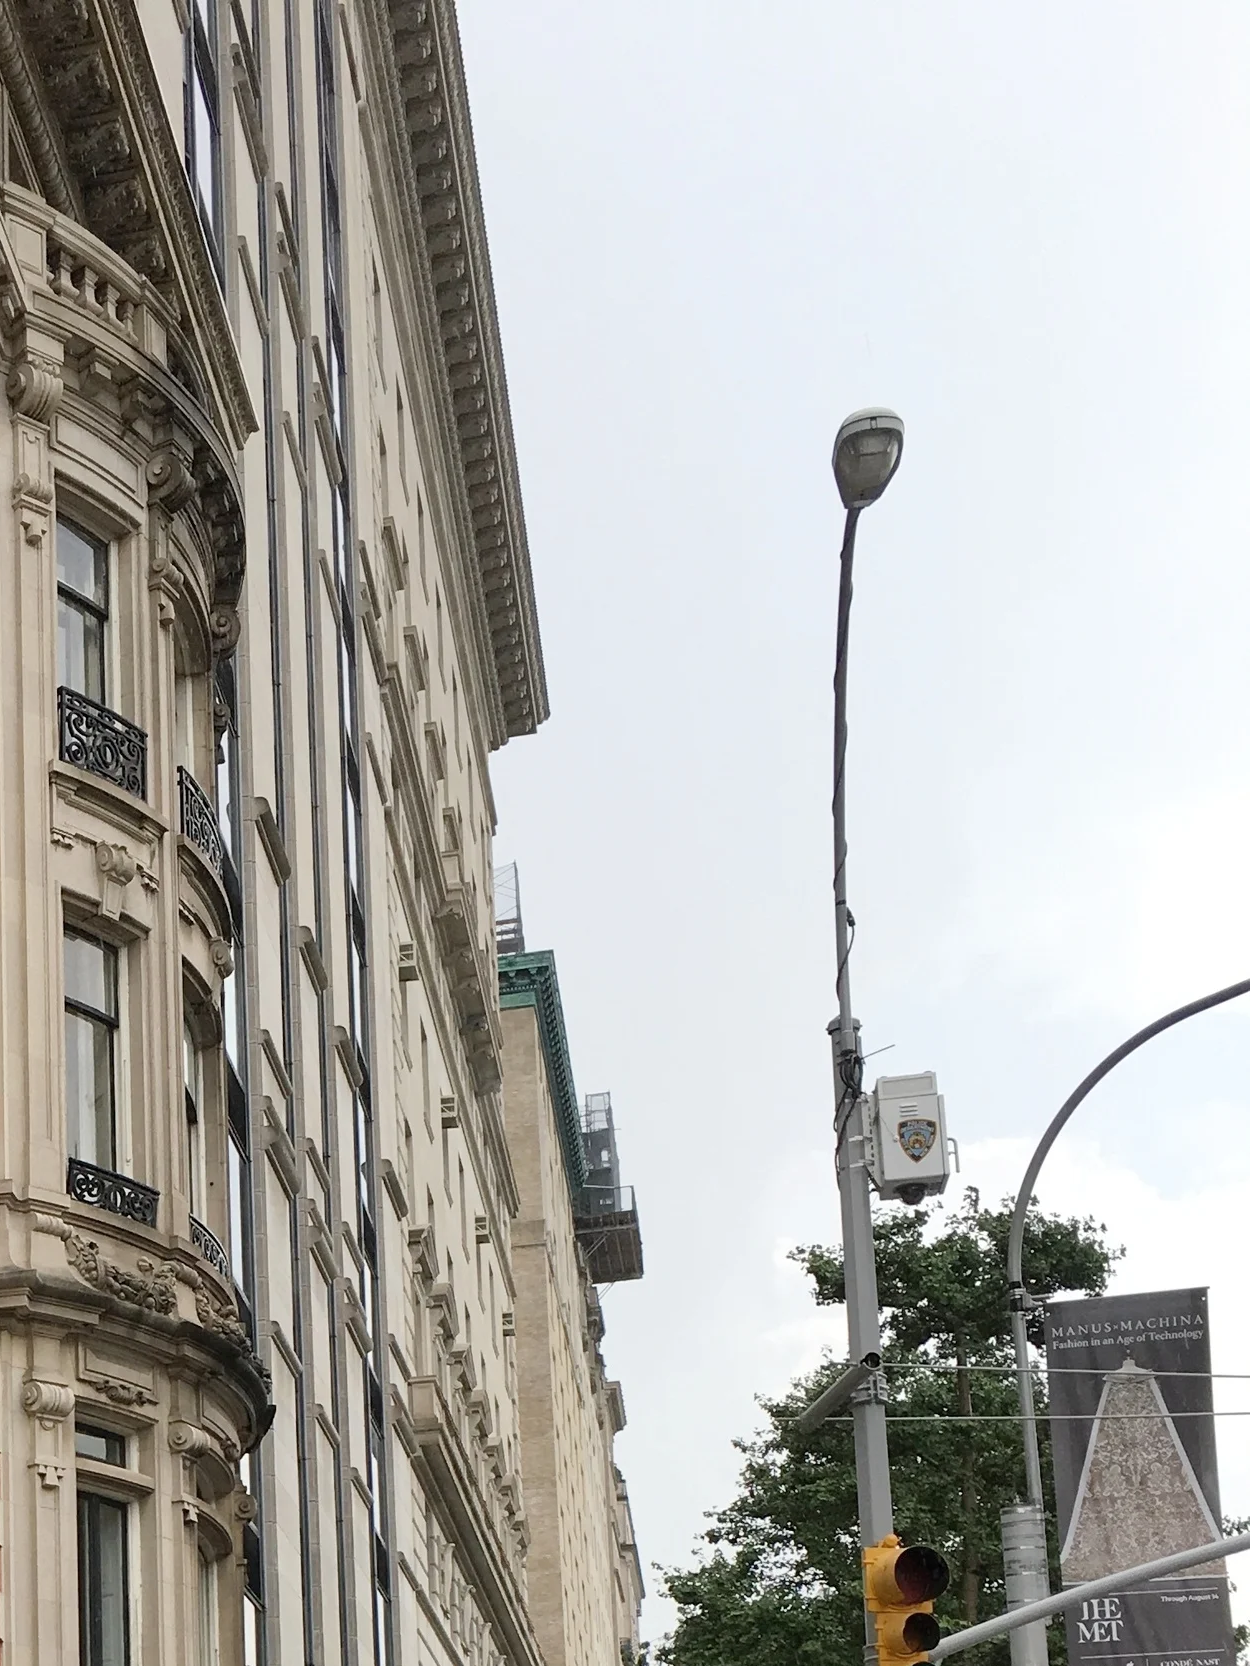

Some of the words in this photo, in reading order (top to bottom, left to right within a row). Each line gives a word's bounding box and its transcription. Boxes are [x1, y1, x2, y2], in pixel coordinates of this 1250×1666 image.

[1051, 1322, 1112, 1338] MANUS
[1120, 1314, 1204, 1331] MACHINA
[1052, 1338, 1089, 1350] Fashion
[1091, 1336, 1100, 1346] in
[1102, 1337, 1114, 1345] an
[1116, 1335, 1134, 1346] Age
[1136, 1332, 1148, 1342] of
[1148, 1329, 1204, 1343] Technology
[1076, 1619, 1124, 1644] MET
[1196, 1658, 1220, 1666] NAST
